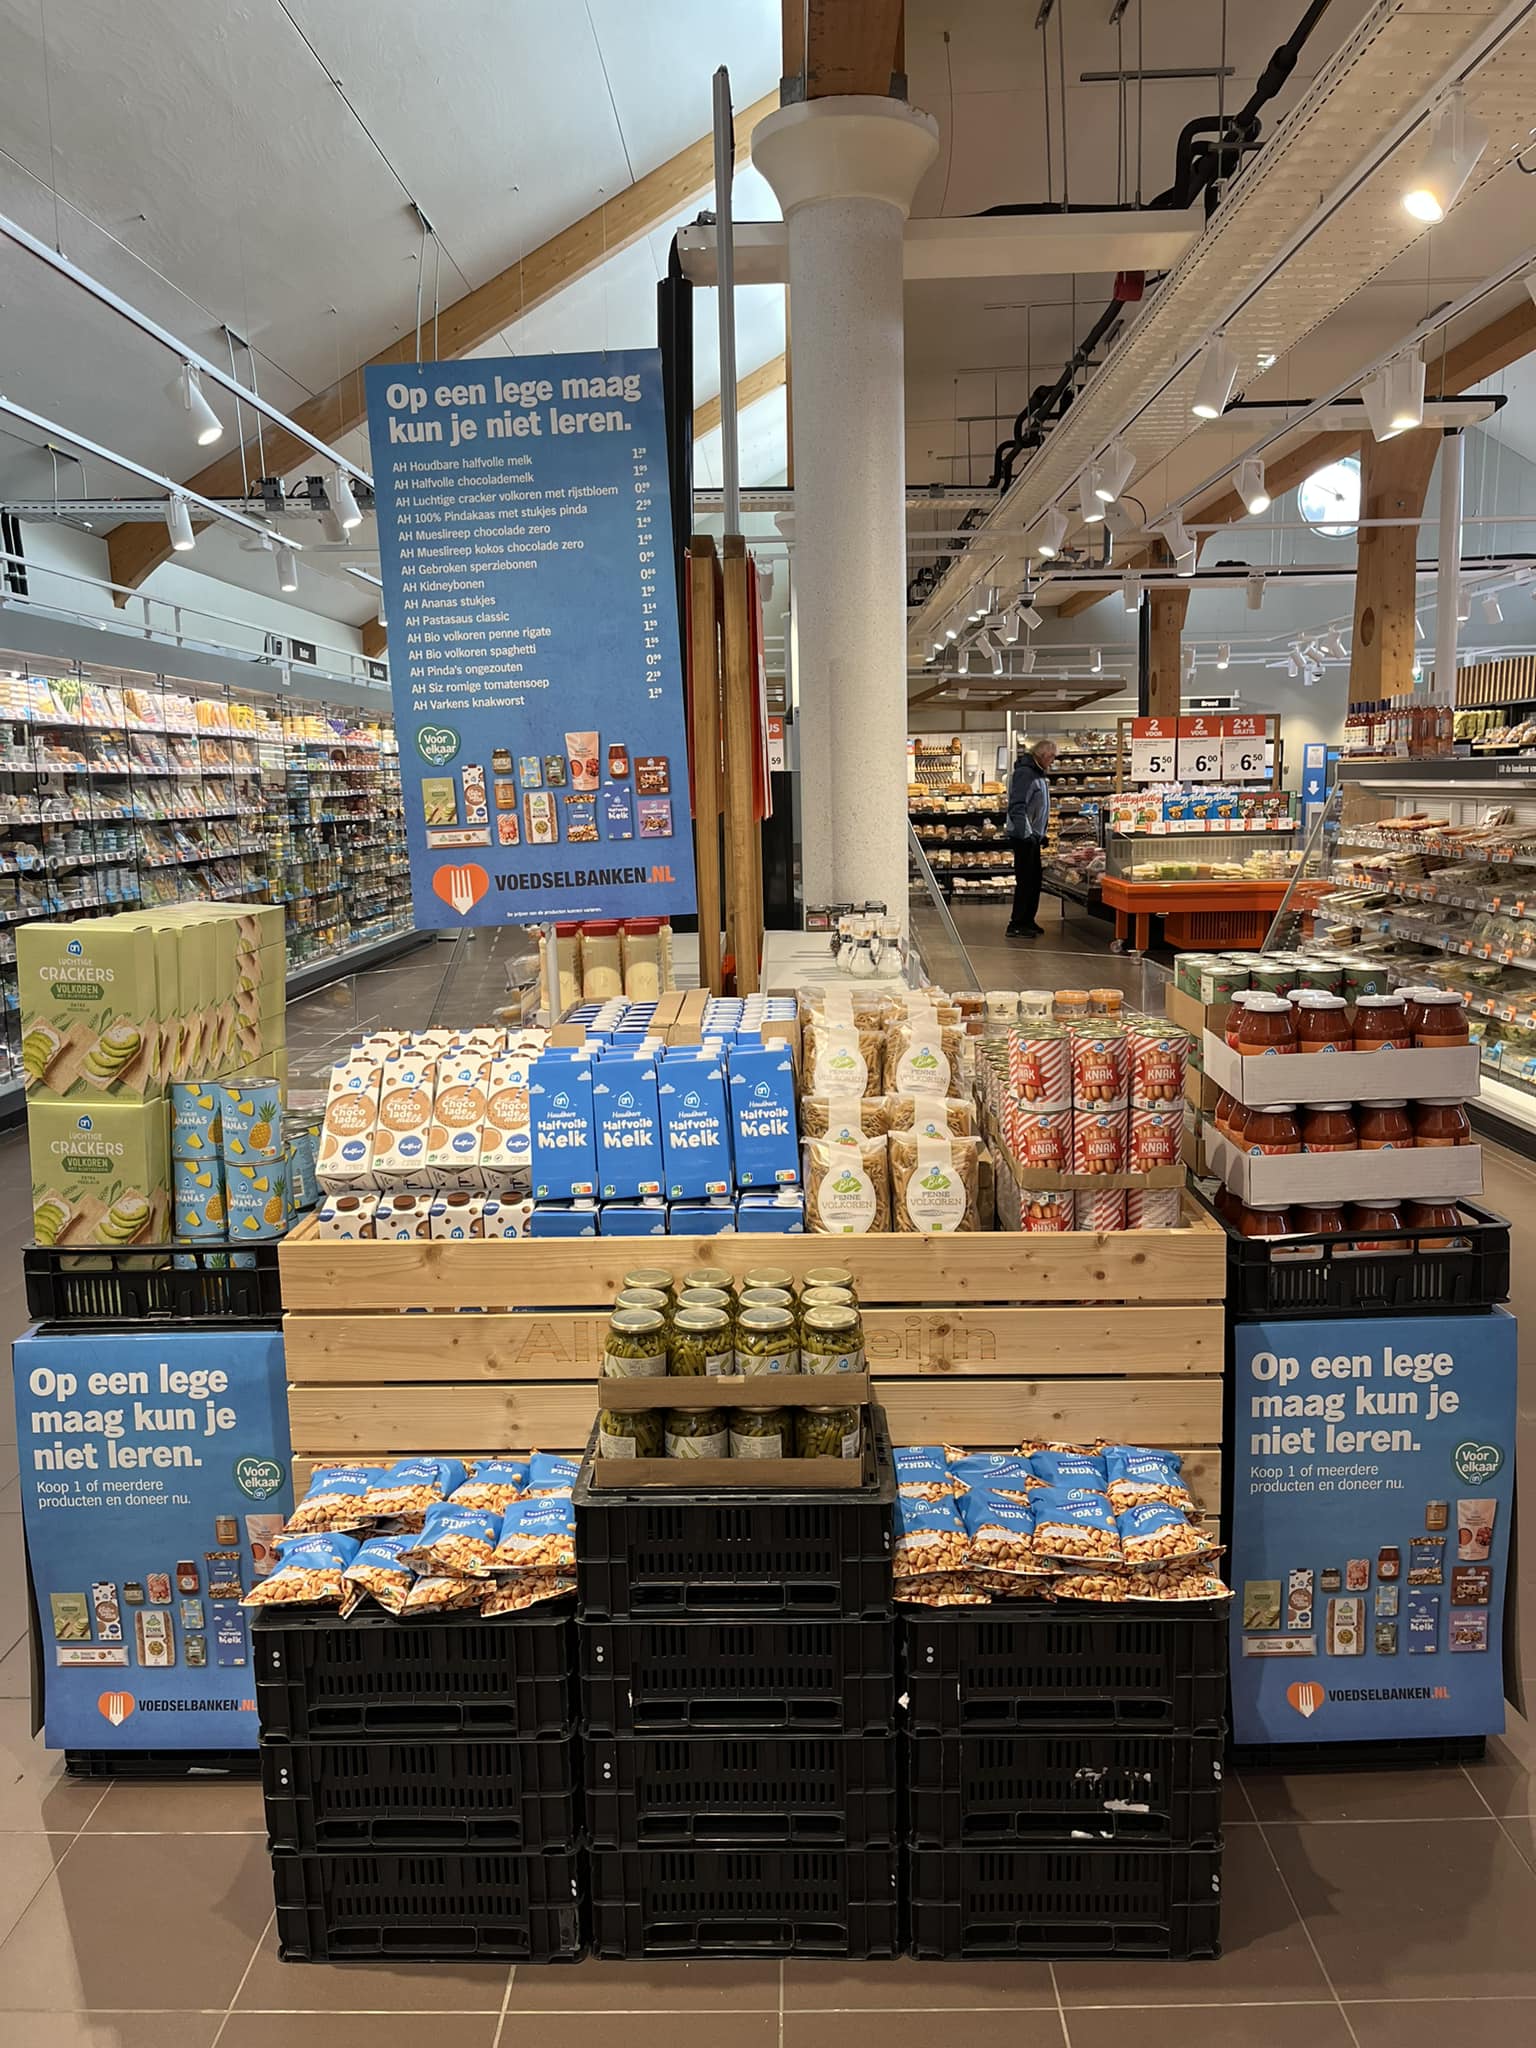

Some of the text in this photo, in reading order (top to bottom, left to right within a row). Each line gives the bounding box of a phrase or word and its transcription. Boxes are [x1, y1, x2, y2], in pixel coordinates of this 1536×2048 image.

[386, 374, 641, 414] Op een lege maag
[389, 408, 632, 446] kun je niet leren.
[393, 455, 532, 472] AH Houdbare halfvolle melk
[394, 472, 534, 490] AH Halfvolle chocolademelk
[396, 486, 618, 507] AH Luchtige cracker volkoren met rijstbloem
[398, 504, 587, 524] AH 100% Pindakaas met stukjes pinda
[399, 525, 550, 541] AH Mueslireep chocolade zero
[400, 540, 584, 558] AH Mueslireep kokos chocolade zero
[402, 560, 537, 575] AH Gebroken sperziebonen
[403, 580, 484, 592] AH Kidneybonen
[404, 595, 496, 609] AH Ananas stukjes
[406, 611, 509, 626] AH Pastasaus classic
[408, 627, 551, 643] AH Bio volkoren penne rigate
[409, 644, 536, 660] AH Bio volkoren spaghetti
[410, 664, 522, 677] AH Pinda's ongezouten
[412, 684, 426, 694] AH
[446, 681, 481, 693] romige
[484, 680, 549, 690] tomatensoep
[414, 696, 524, 710] AH Varkens knakworst
[1150, 720, 1158, 731] 2
[1195, 719, 1204, 730] 2
[1233, 719, 1255, 729] 2+1
[423, 734, 447, 744] Voor
[425, 744, 456, 754] elkaar
[494, 865, 675, 891] VOEDSELBANKEN.NL
[40, 967, 114, 982] CRACKERS
[56, 984, 99, 994] VOLKOREN
[1085, 1069, 1113, 1080] KNAK
[1147, 1069, 1176, 1080] KNAK
[740, 1107, 789, 1119] Halfvolle
[538, 1118, 588, 1130] Halfvolle
[603, 1118, 653, 1130] Halfvolle
[669, 1117, 719, 1129] Halfvolle
[741, 1119, 790, 1137] Melk
[539, 1129, 589, 1149] Melk
[604, 1129, 654, 1149] Melk
[670, 1128, 720, 1148] Melk
[51, 1141, 124, 1155] CRACKERS
[1030, 1144, 1058, 1155] KNAK
[1088, 1143, 1117, 1154] KNAK
[67, 1158, 108, 1167] VOLKOREN
[864, 1315, 997, 1372] eijn
[1252, 1347, 1453, 1386] Op een lege
[30, 1364, 228, 1402] Op een lege
[1252, 1384, 1459, 1422] maag kun je
[32, 1400, 236, 1437] maag kun je
[1251, 1425, 1421, 1454] niet leren.
[34, 1440, 202, 1470] niet leren.
[1462, 1450, 1489, 1461] Voor
[243, 1466, 270, 1477] Voor
[1251, 1464, 1378, 1479] Koop 1 of meerdere
[1462, 1462, 1498, 1472] elkaar
[37, 1479, 163, 1494] Koop 1 of meerdere
[245, 1477, 280, 1488] elkaar
[1251, 1478, 1404, 1494] producten en doneer nu.
[39, 1494, 191, 1510] producten en doneer nu.
[1328, 1686, 1450, 1702] VOEDSELBANKEN.NL
[139, 1699, 258, 1712] VOEDSELBANKEN.NL
